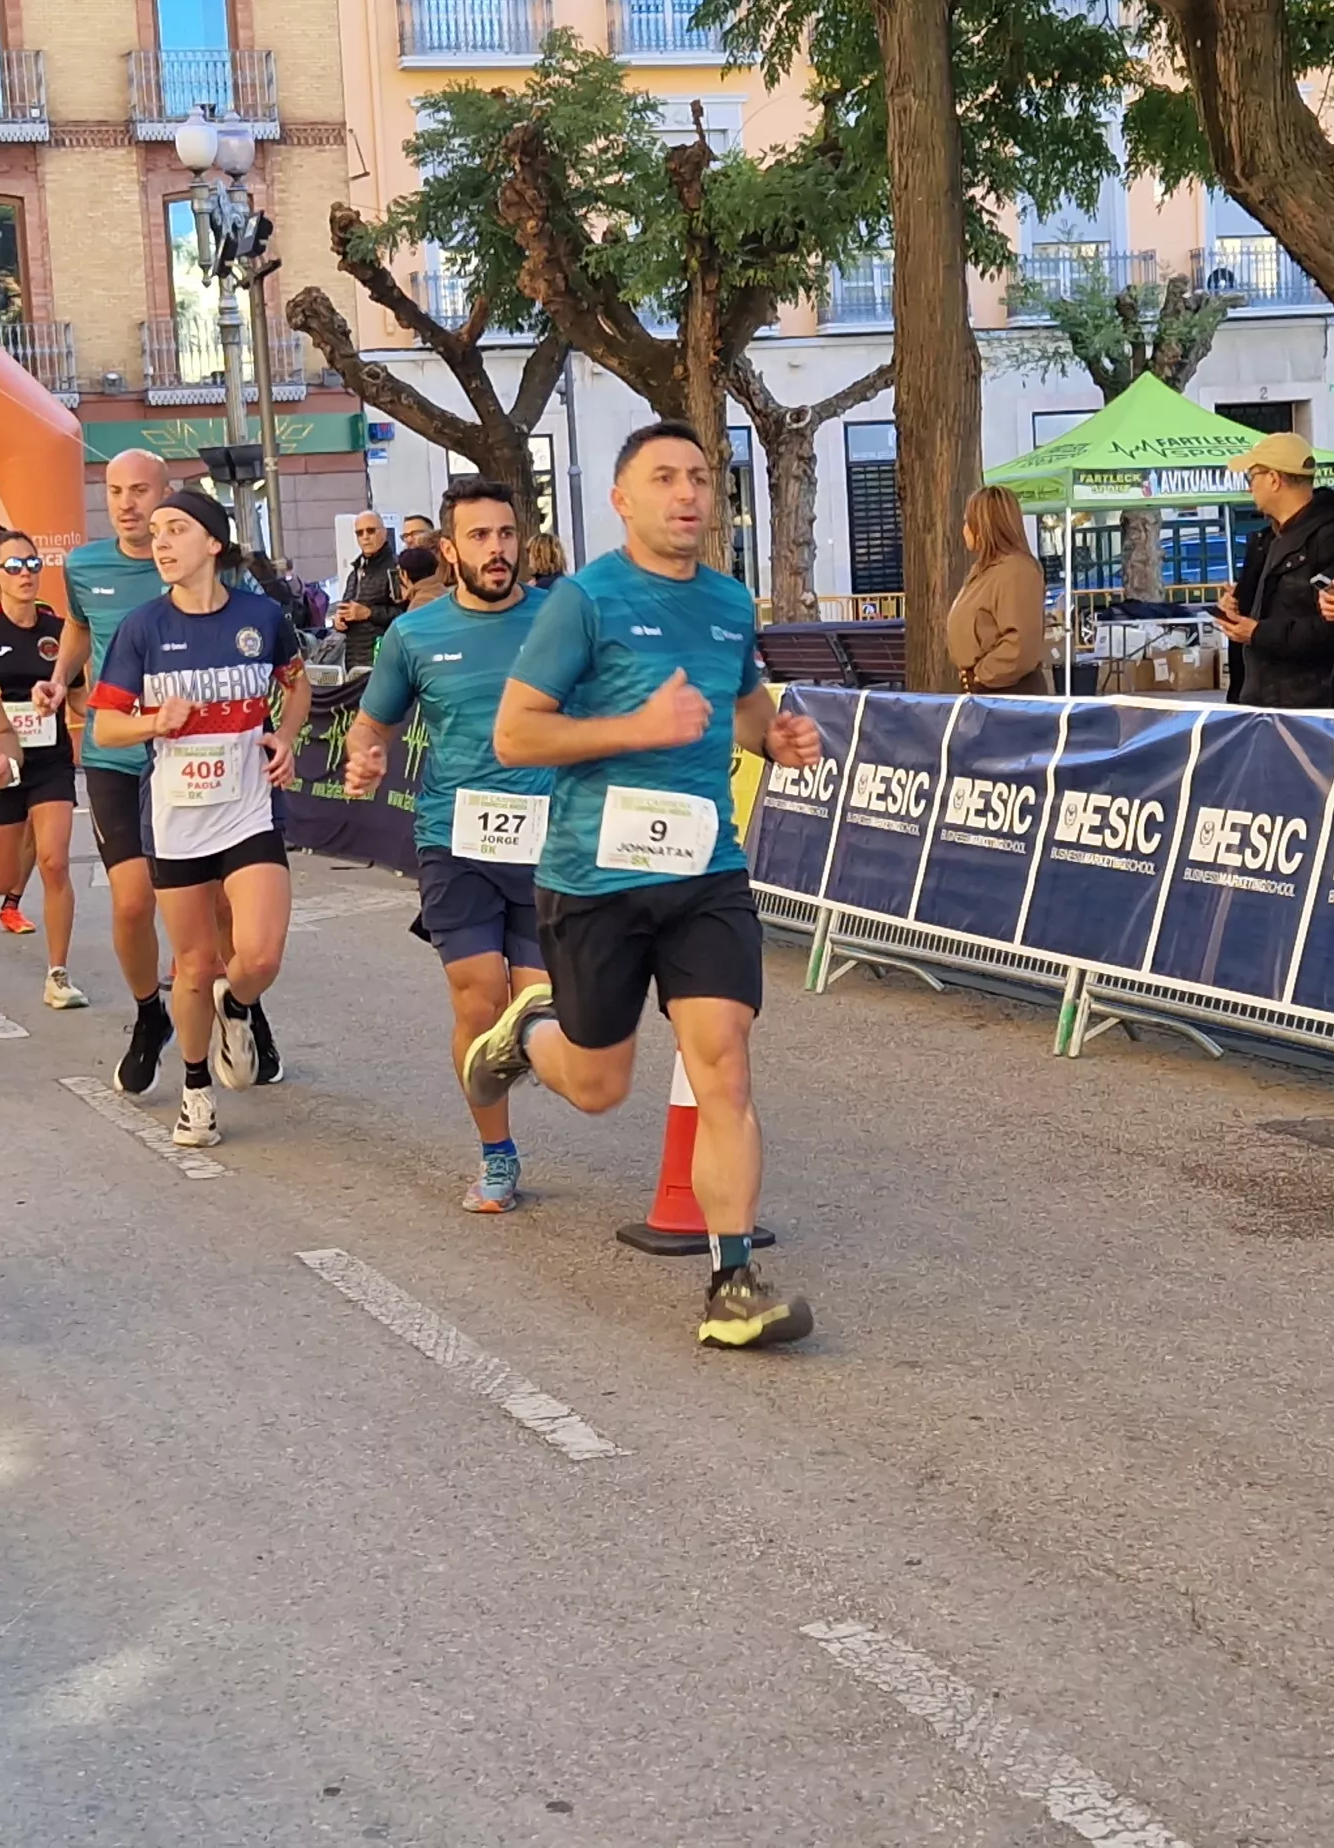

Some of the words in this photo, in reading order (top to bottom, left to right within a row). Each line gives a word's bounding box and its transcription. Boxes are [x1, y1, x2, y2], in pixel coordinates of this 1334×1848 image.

[1259, 386, 1269, 400] 2
[1171, 448, 1246, 458] SPOR
[1161, 469, 1250, 493] AVITUALLAM
[32, 530, 81, 546] miento
[151, 663, 268, 704] BOMBEROS
[12, 714, 42, 728] 551
[181, 760, 225, 779] 408
[869, 765, 931, 818] ESIC
[966, 779, 1036, 835] ESIC
[478, 812, 527, 833] 127
[649, 820, 667, 841] 9
[1080, 793, 1165, 854] ESIC
[480, 835, 520, 845] JORGE
[1218, 810, 1307, 875] ESIC
